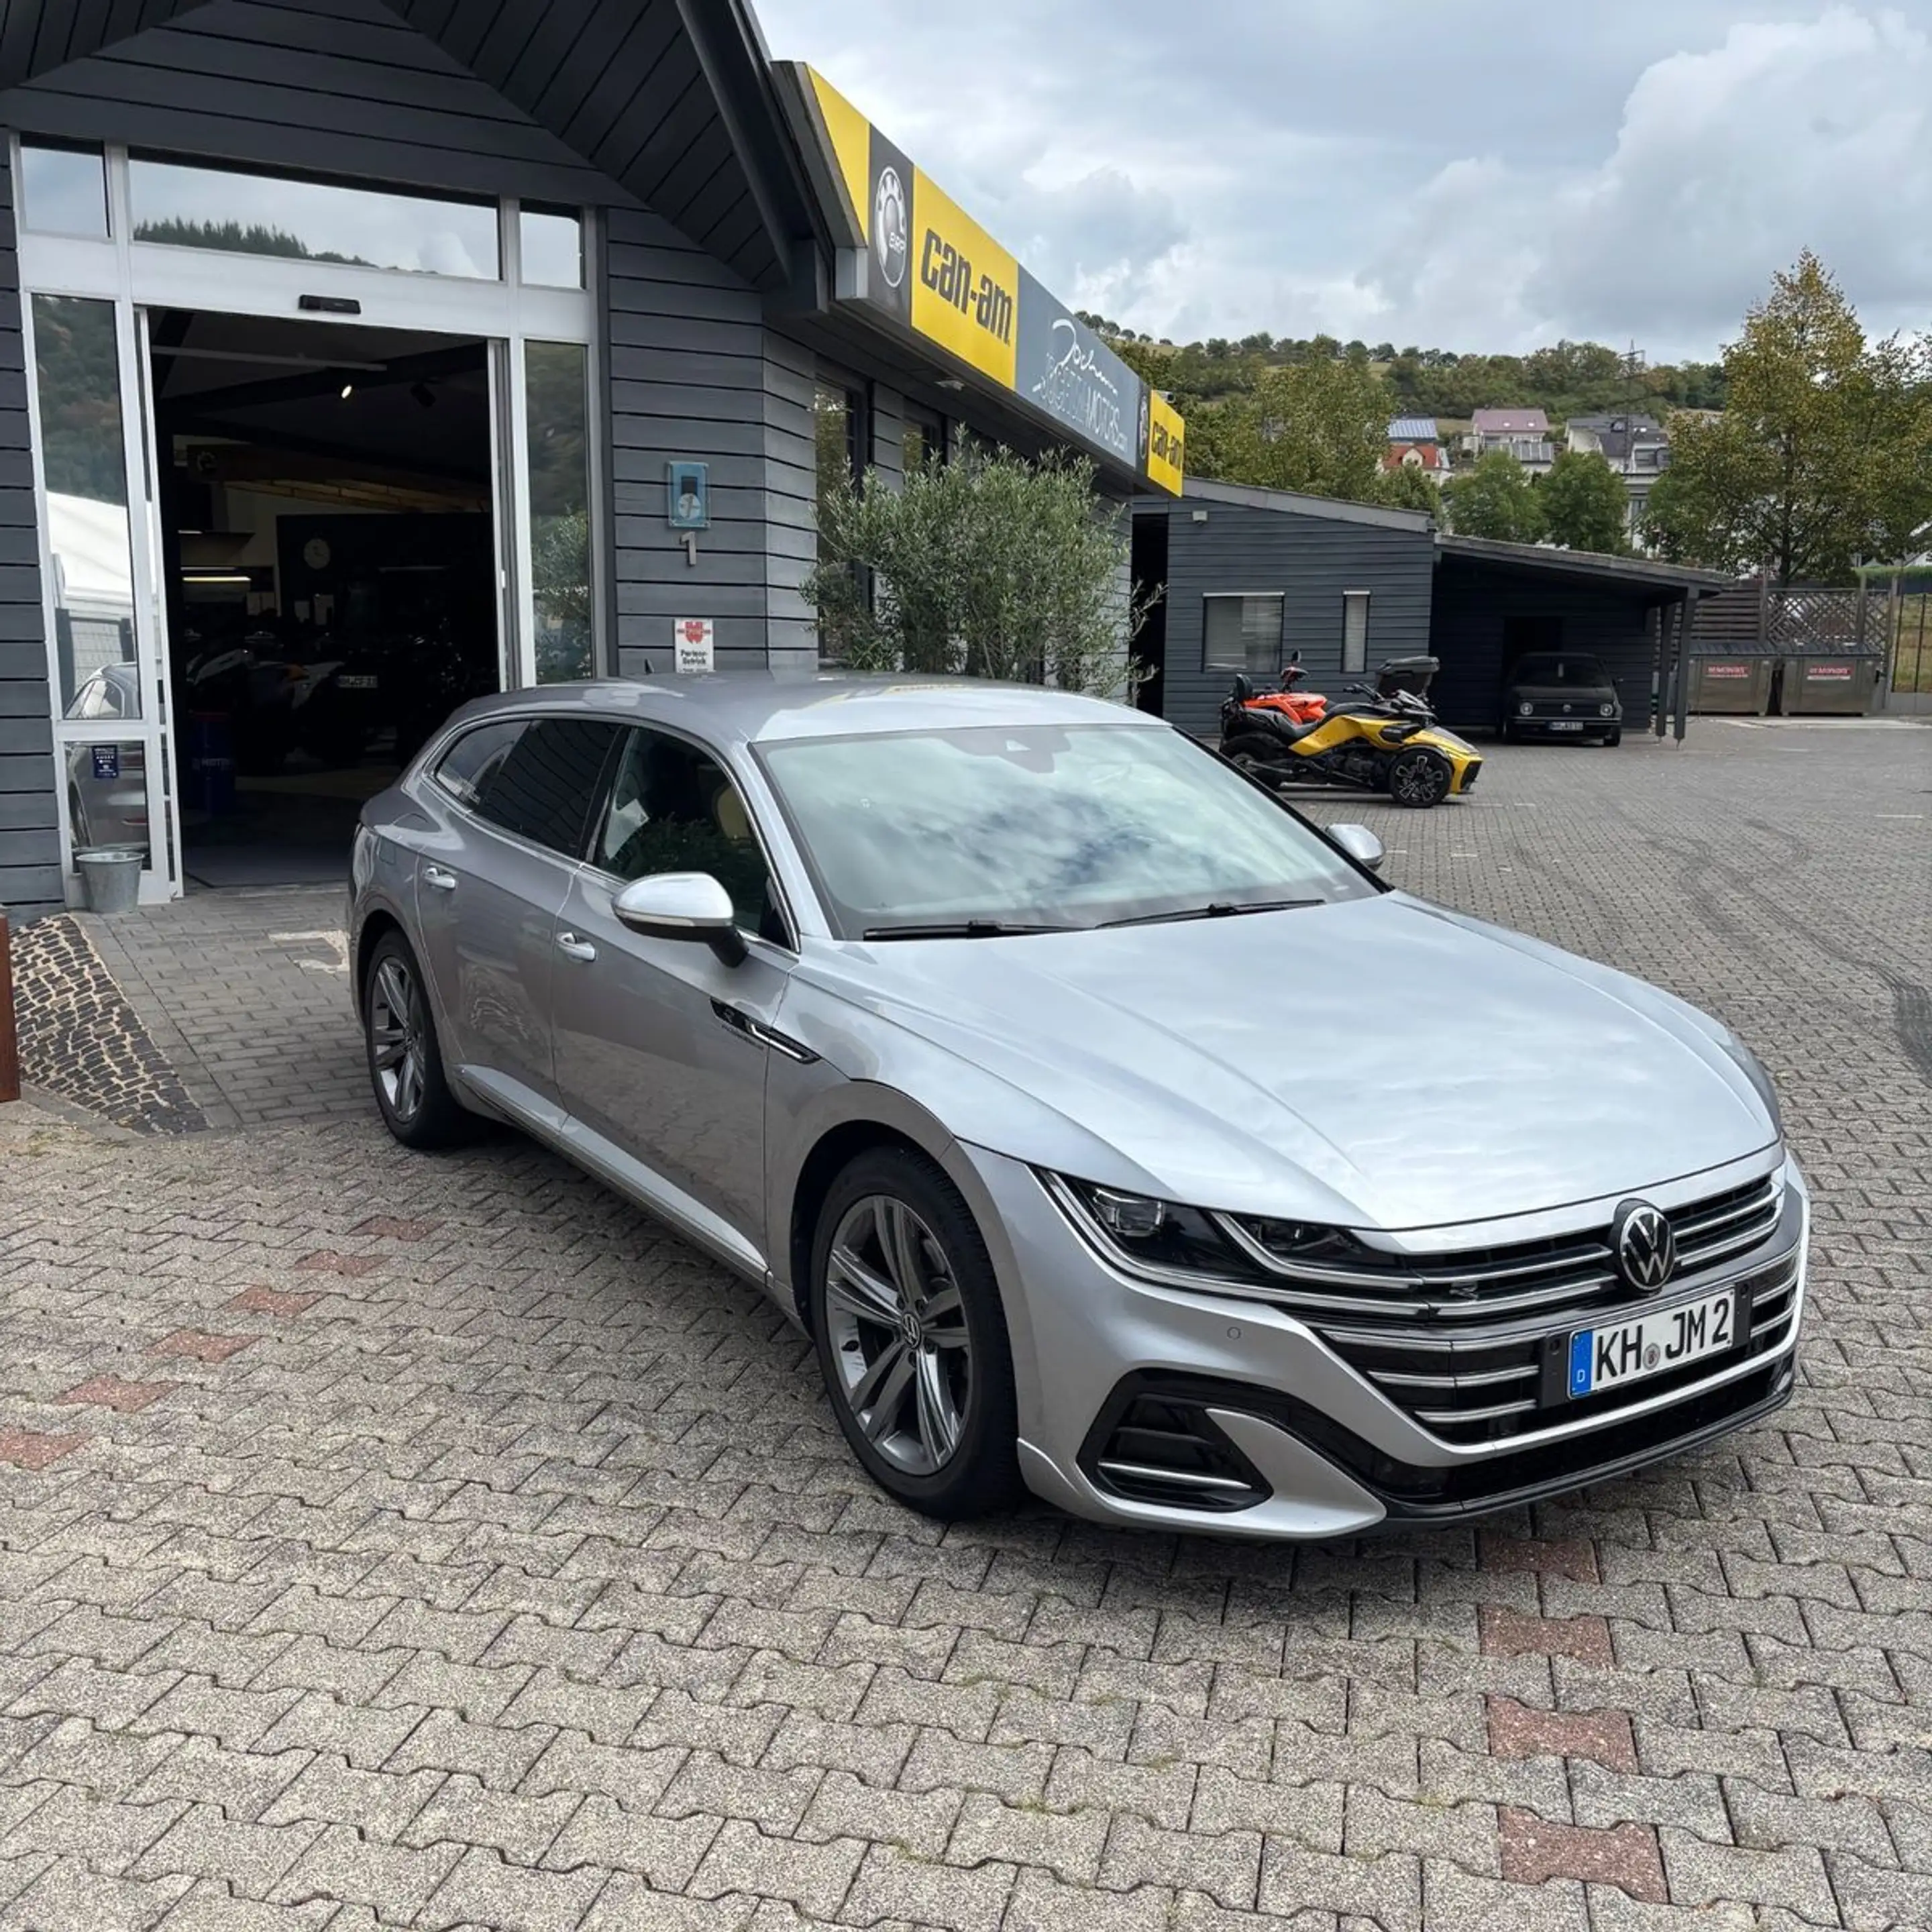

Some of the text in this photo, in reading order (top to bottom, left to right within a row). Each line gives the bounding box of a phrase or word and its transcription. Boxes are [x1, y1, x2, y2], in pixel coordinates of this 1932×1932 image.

[680, 531, 696, 566] 1
[1596, 1297, 1729, 1381] KH JM 2
[1577, 1369, 1585, 1383] D
